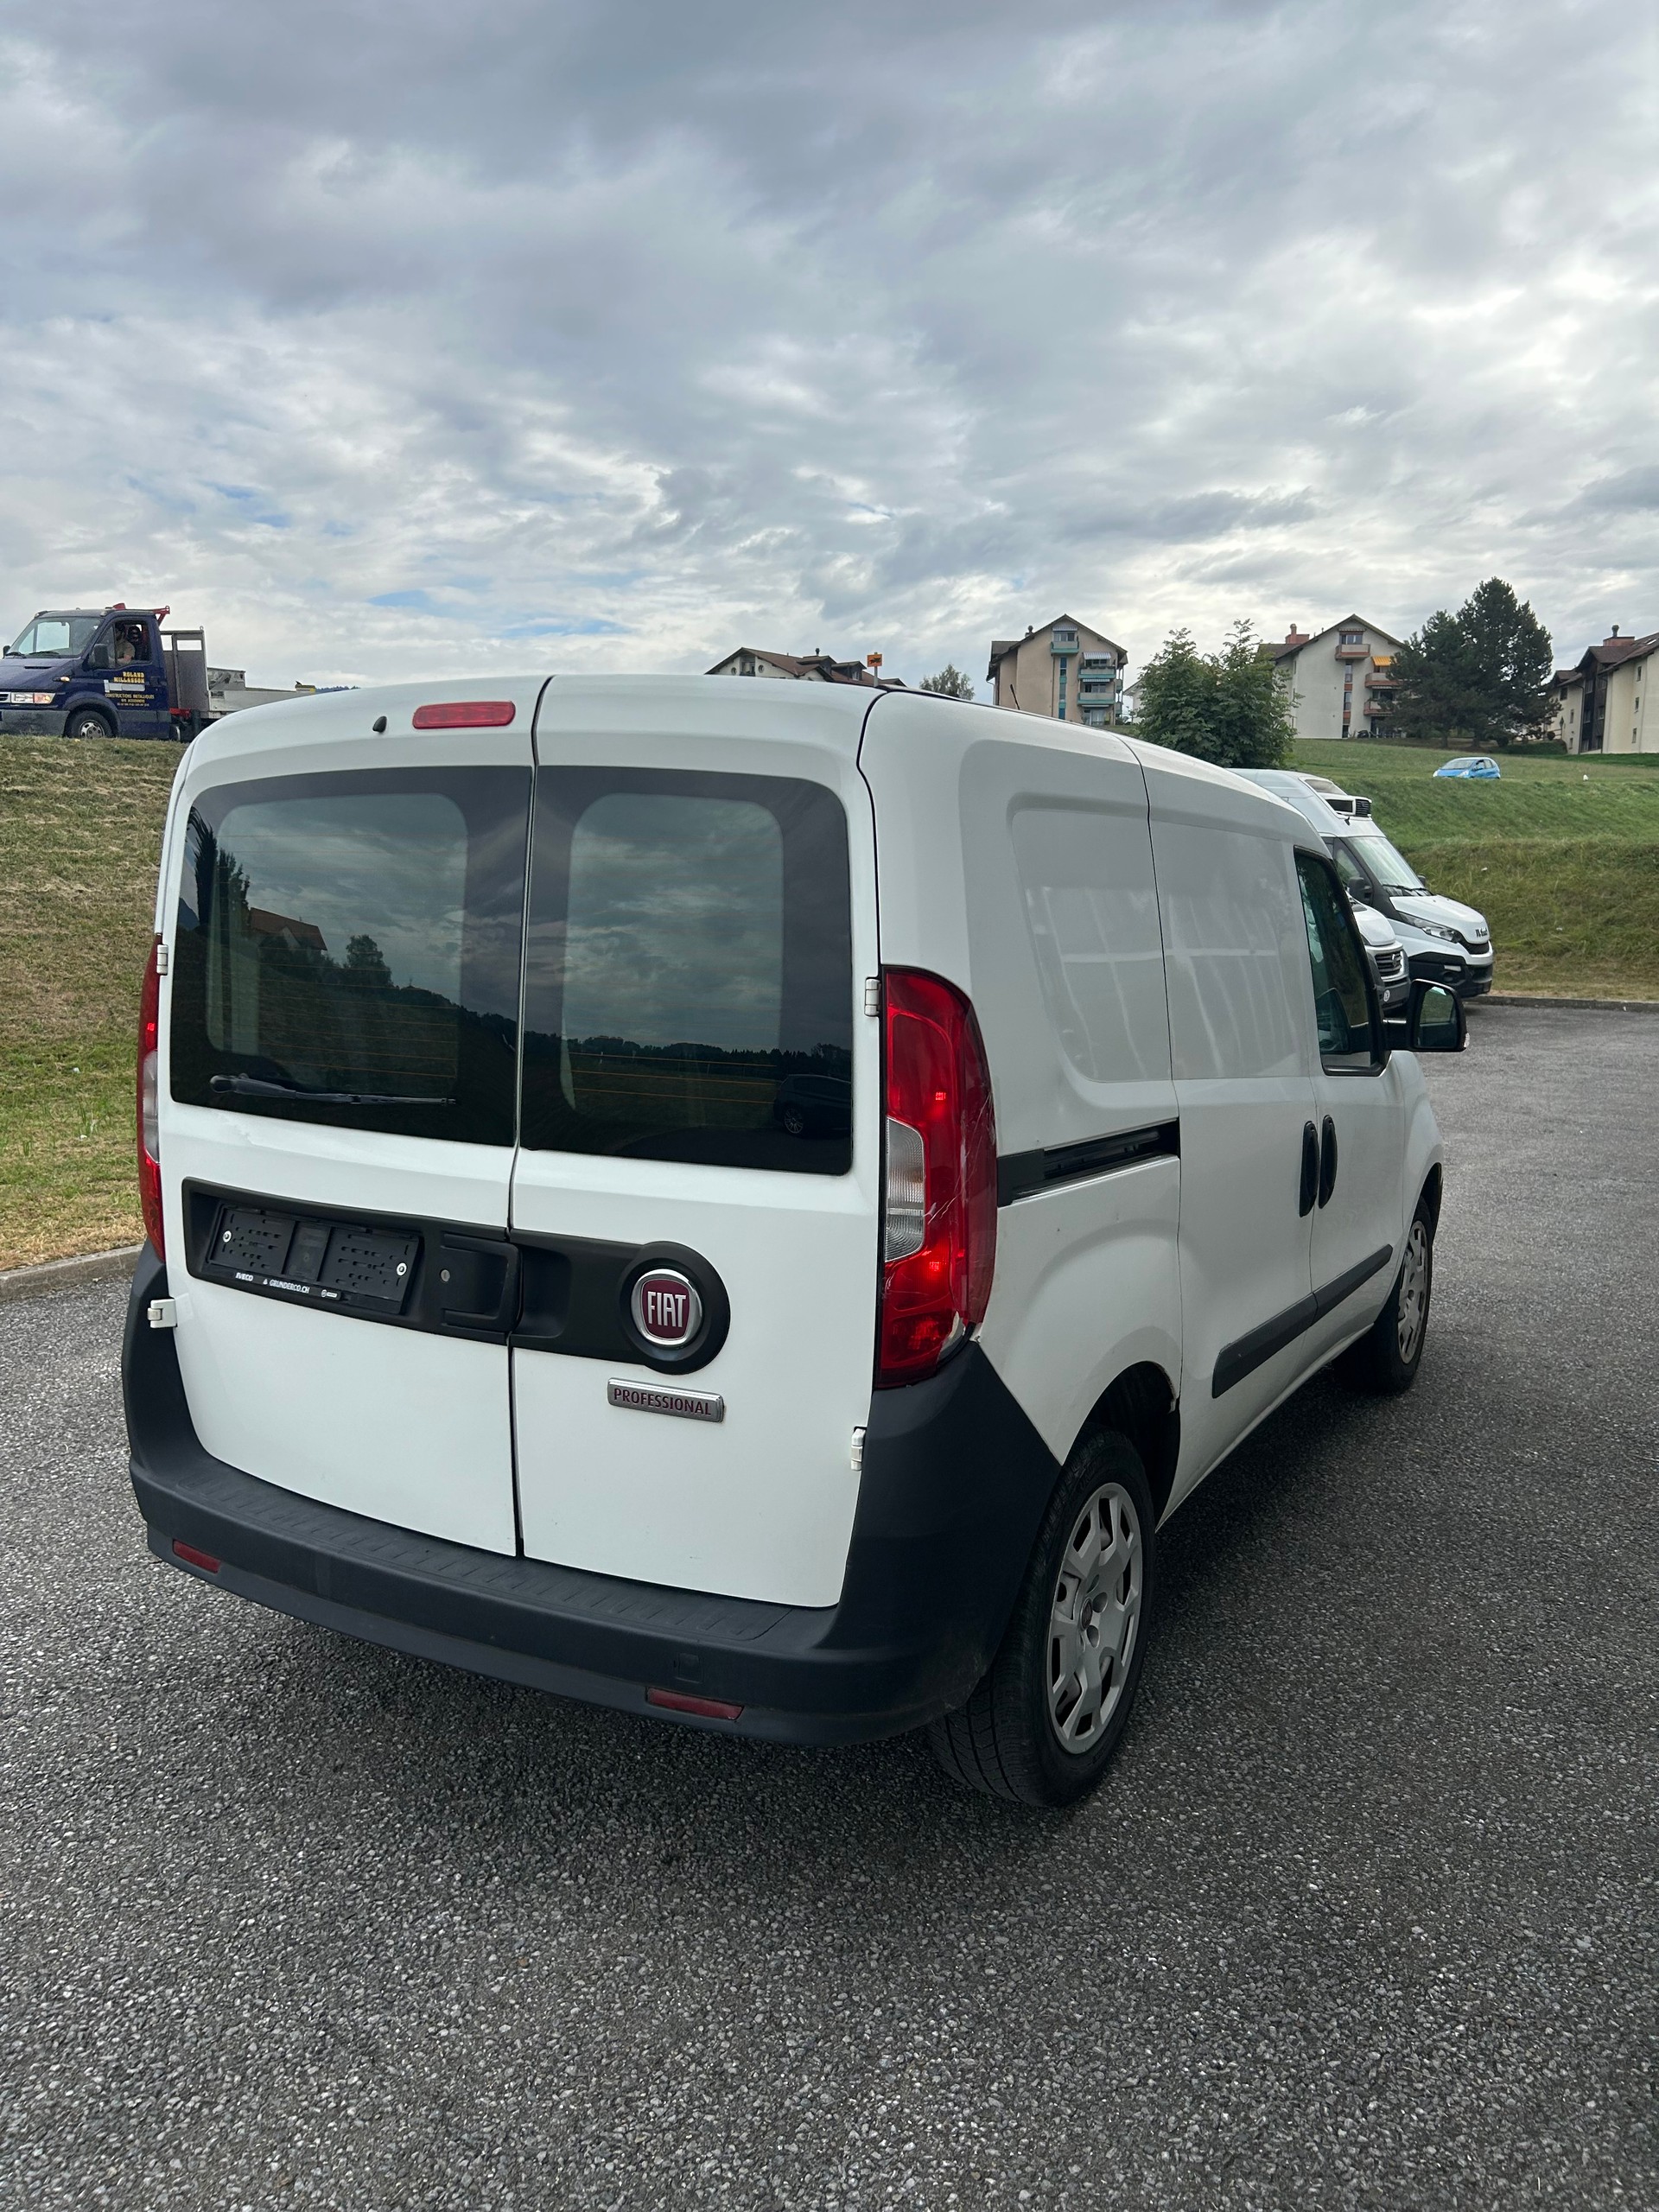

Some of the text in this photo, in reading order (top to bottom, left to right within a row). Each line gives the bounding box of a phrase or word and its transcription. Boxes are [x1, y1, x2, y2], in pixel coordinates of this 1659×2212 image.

[235, 1272, 254, 1281] IVECO
[269, 1279, 310, 1294] GRUNDERCO.CH
[647, 1291, 687, 1328] FIAT
[613, 1388, 712, 1416] PROFESSIONAL
